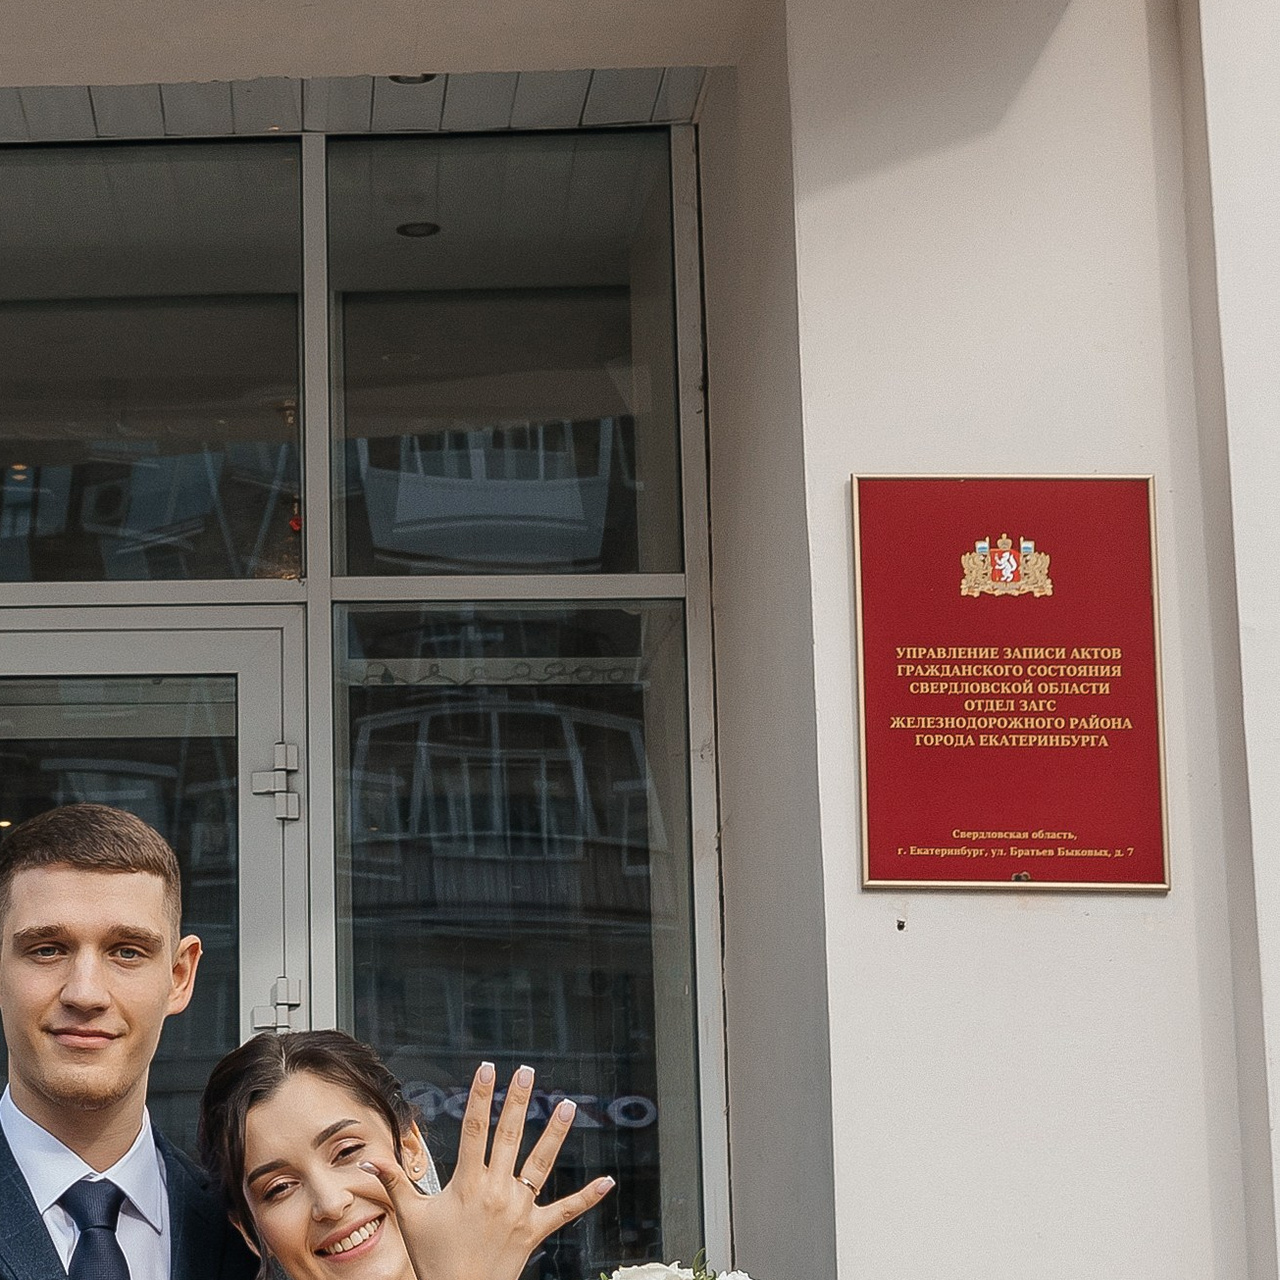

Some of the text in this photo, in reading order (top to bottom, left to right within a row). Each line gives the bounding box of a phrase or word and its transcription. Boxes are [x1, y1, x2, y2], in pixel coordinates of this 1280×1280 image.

[895, 647, 1122, 659] УПРАВЛЕНИЕ ЗАПИСИ АКТОВ
[897, 664, 1122, 677] ГРАЖДАНСКОГО СОСТОЯНИЯ
[909, 679, 1110, 695] СВЕРДЛОВСКОЙ ОБЛАСТИ
[964, 700, 1057, 712] ОТДЕЛ ЗАГС
[890, 714, 1133, 730] ЖЕЛЕЗНОДОРОЖНОГО РАЙОНА
[915, 734, 1109, 747] ГОРОДА ЕКАТЕРИНБУРГА
[952, 829, 1078, 841] Свердловская область,
[897, 846, 1135, 858] г. Екатеринбург, ул. Братьев Быковых, д. 7
